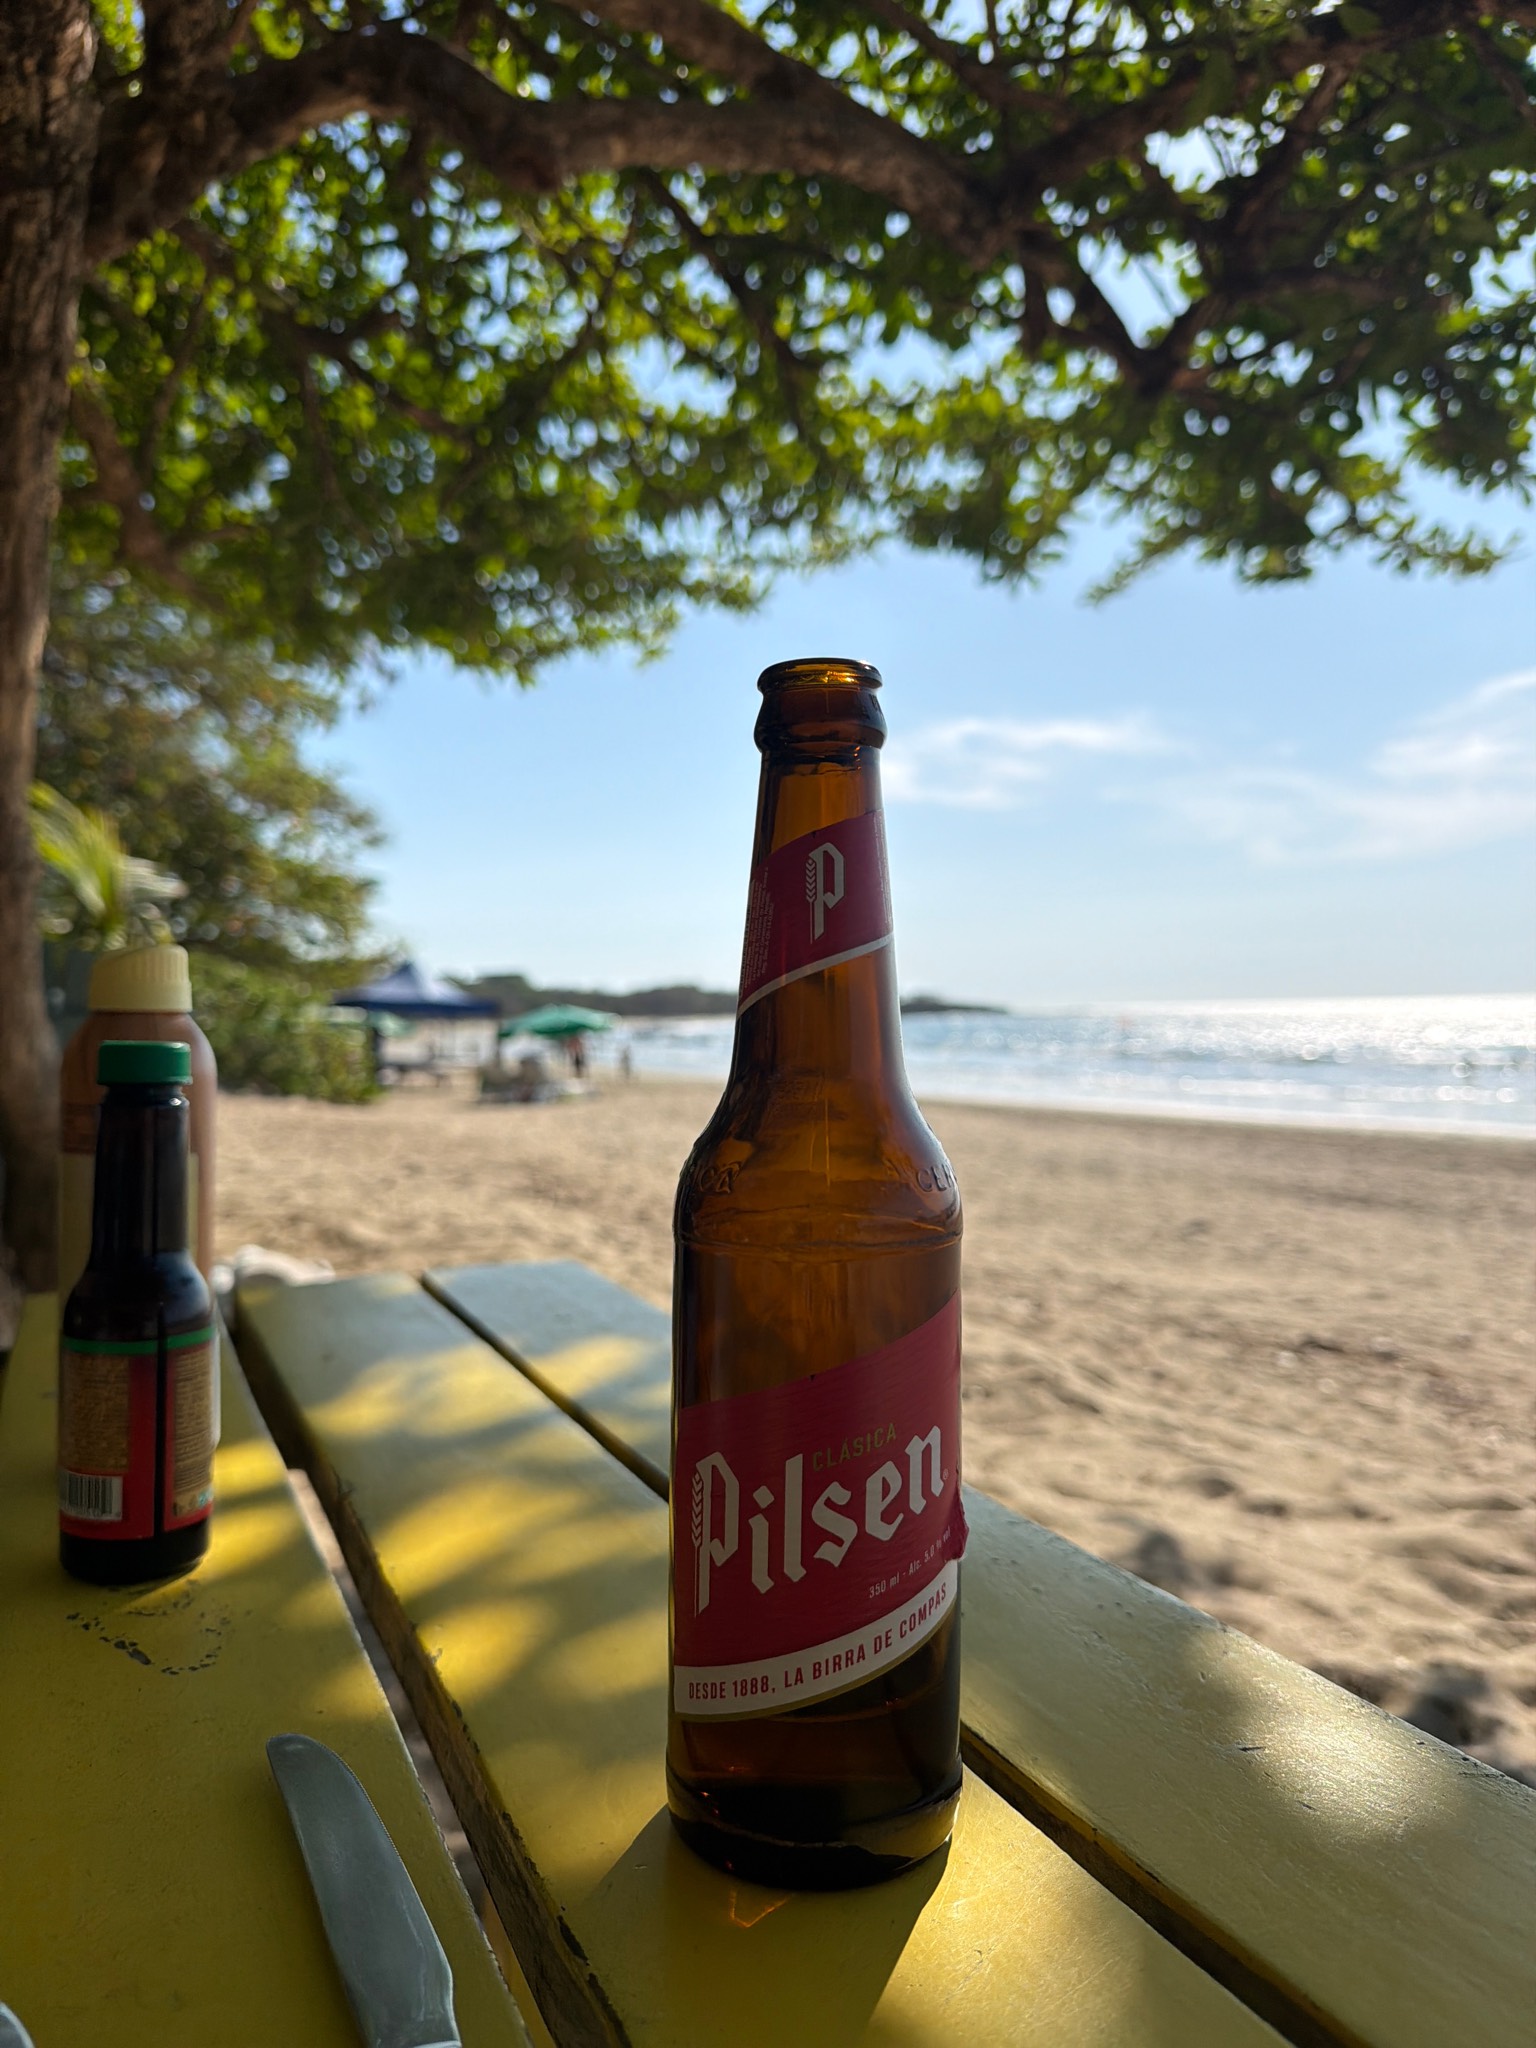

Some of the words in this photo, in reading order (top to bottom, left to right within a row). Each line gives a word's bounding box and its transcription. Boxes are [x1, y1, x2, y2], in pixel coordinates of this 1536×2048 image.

[691, 1424, 944, 1618] Pilsen
[869, 1578, 887, 1599] 350
[889, 1571, 900, 1590] ml
[924, 1545, 936, 1563] 5.0
[688, 1681, 727, 1700] DESDE
[732, 1674, 776, 1699] 1888,
[784, 1670, 804, 1688] LA
[812, 1644, 866, 1680] BIRRA
[873, 1629, 893, 1655] DE
[900, 1581, 947, 1640] COMPAS
